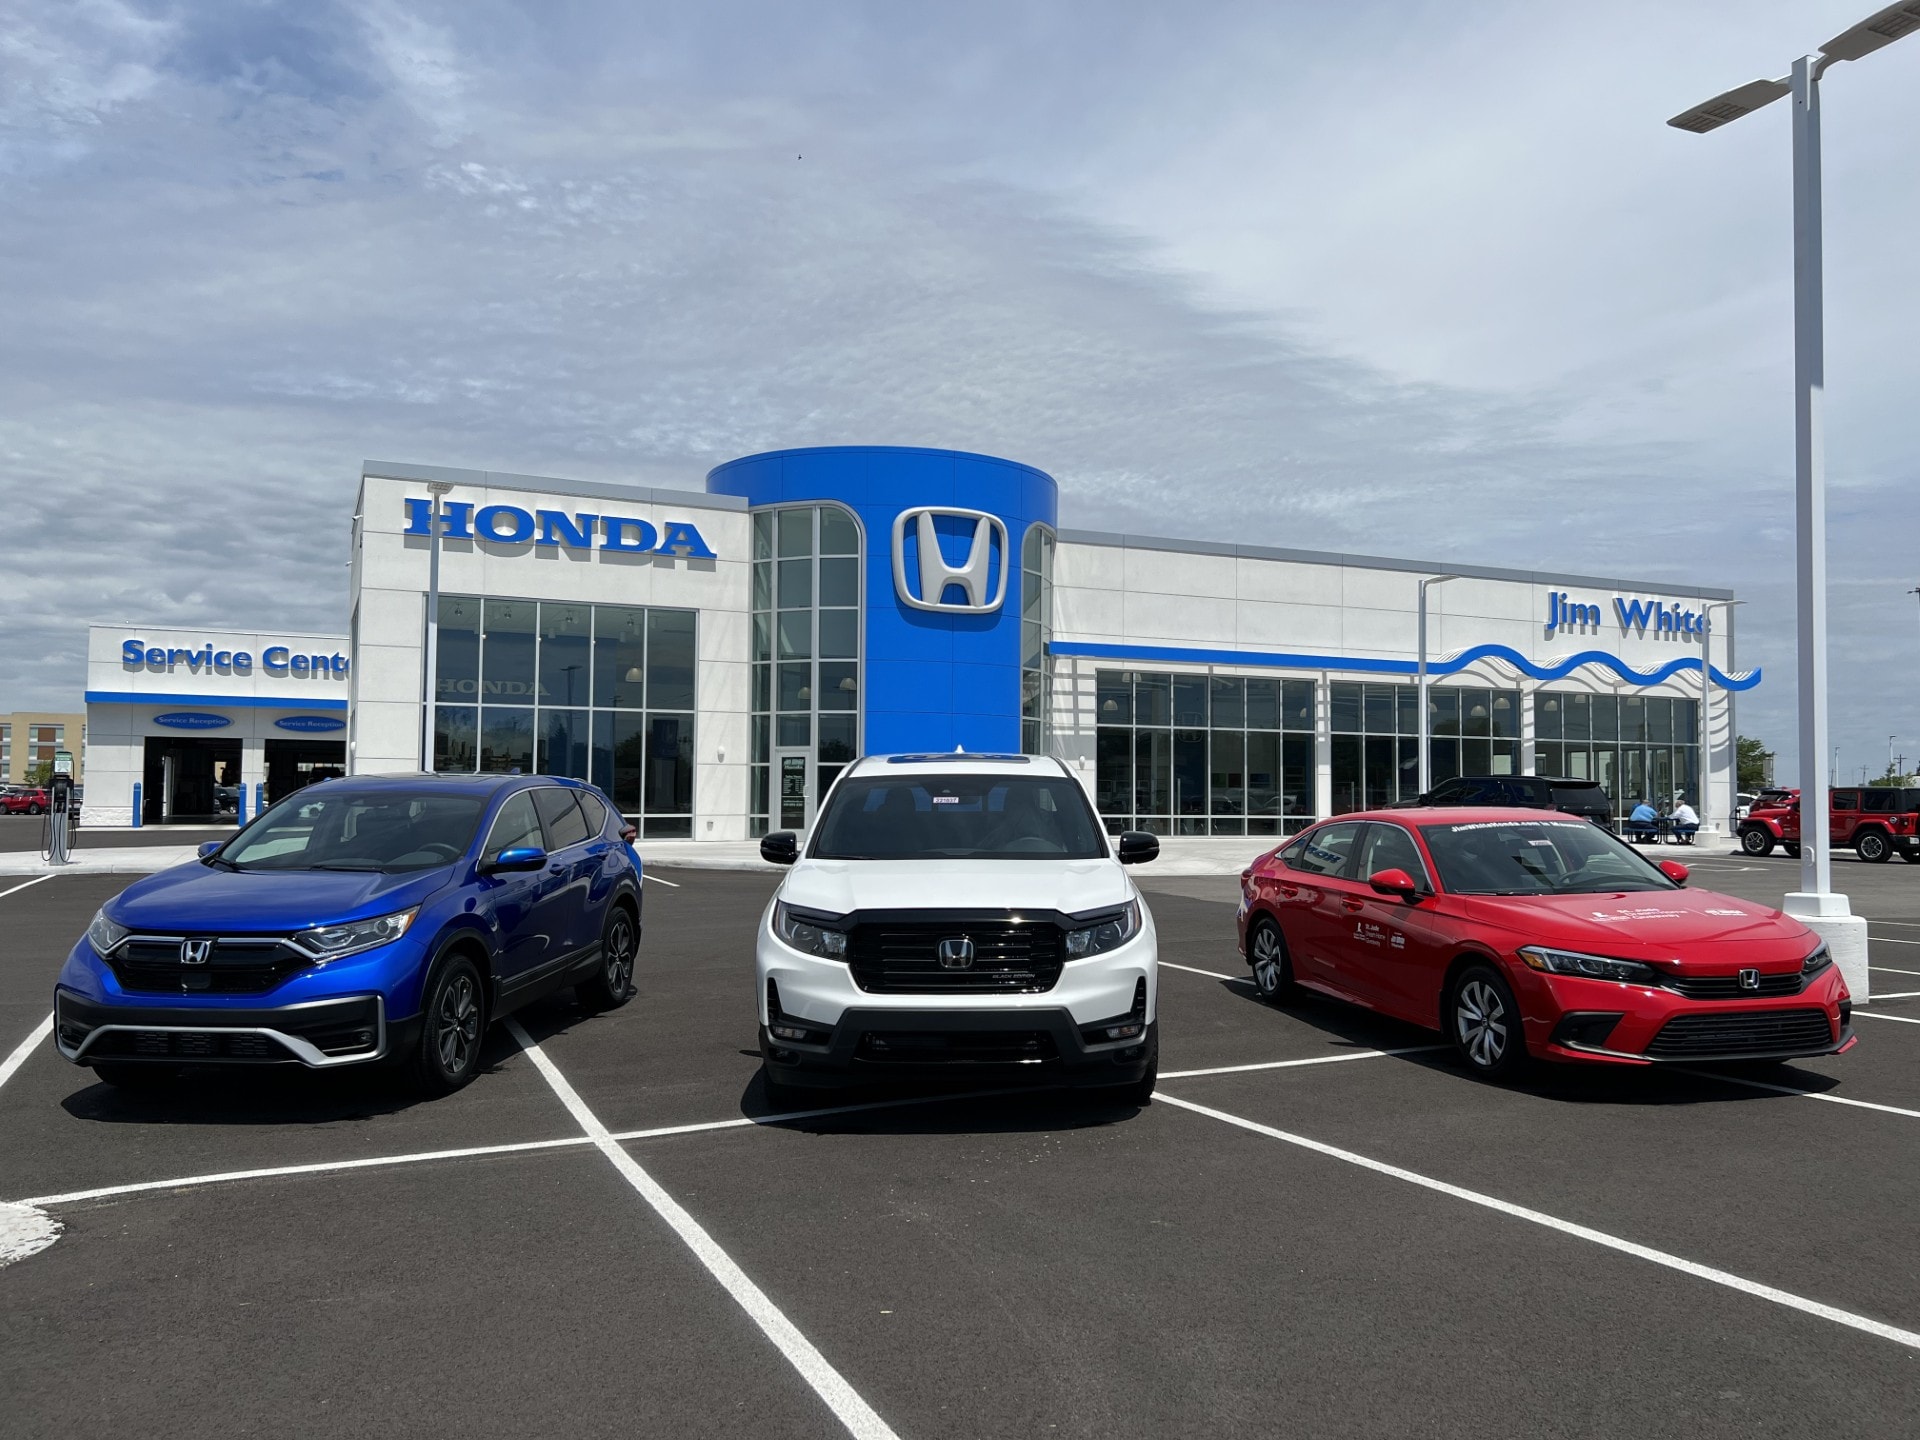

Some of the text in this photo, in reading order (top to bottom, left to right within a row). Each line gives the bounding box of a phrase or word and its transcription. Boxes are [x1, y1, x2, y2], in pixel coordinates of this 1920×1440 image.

[404, 497, 718, 560] HONDA
[1546, 591, 1601, 631] Jim
[122, 639, 253, 669] Service
[435, 678, 551, 696] HONDA
[158, 716, 229, 726] Service Reception
[279, 720, 344, 729] Service Reception
